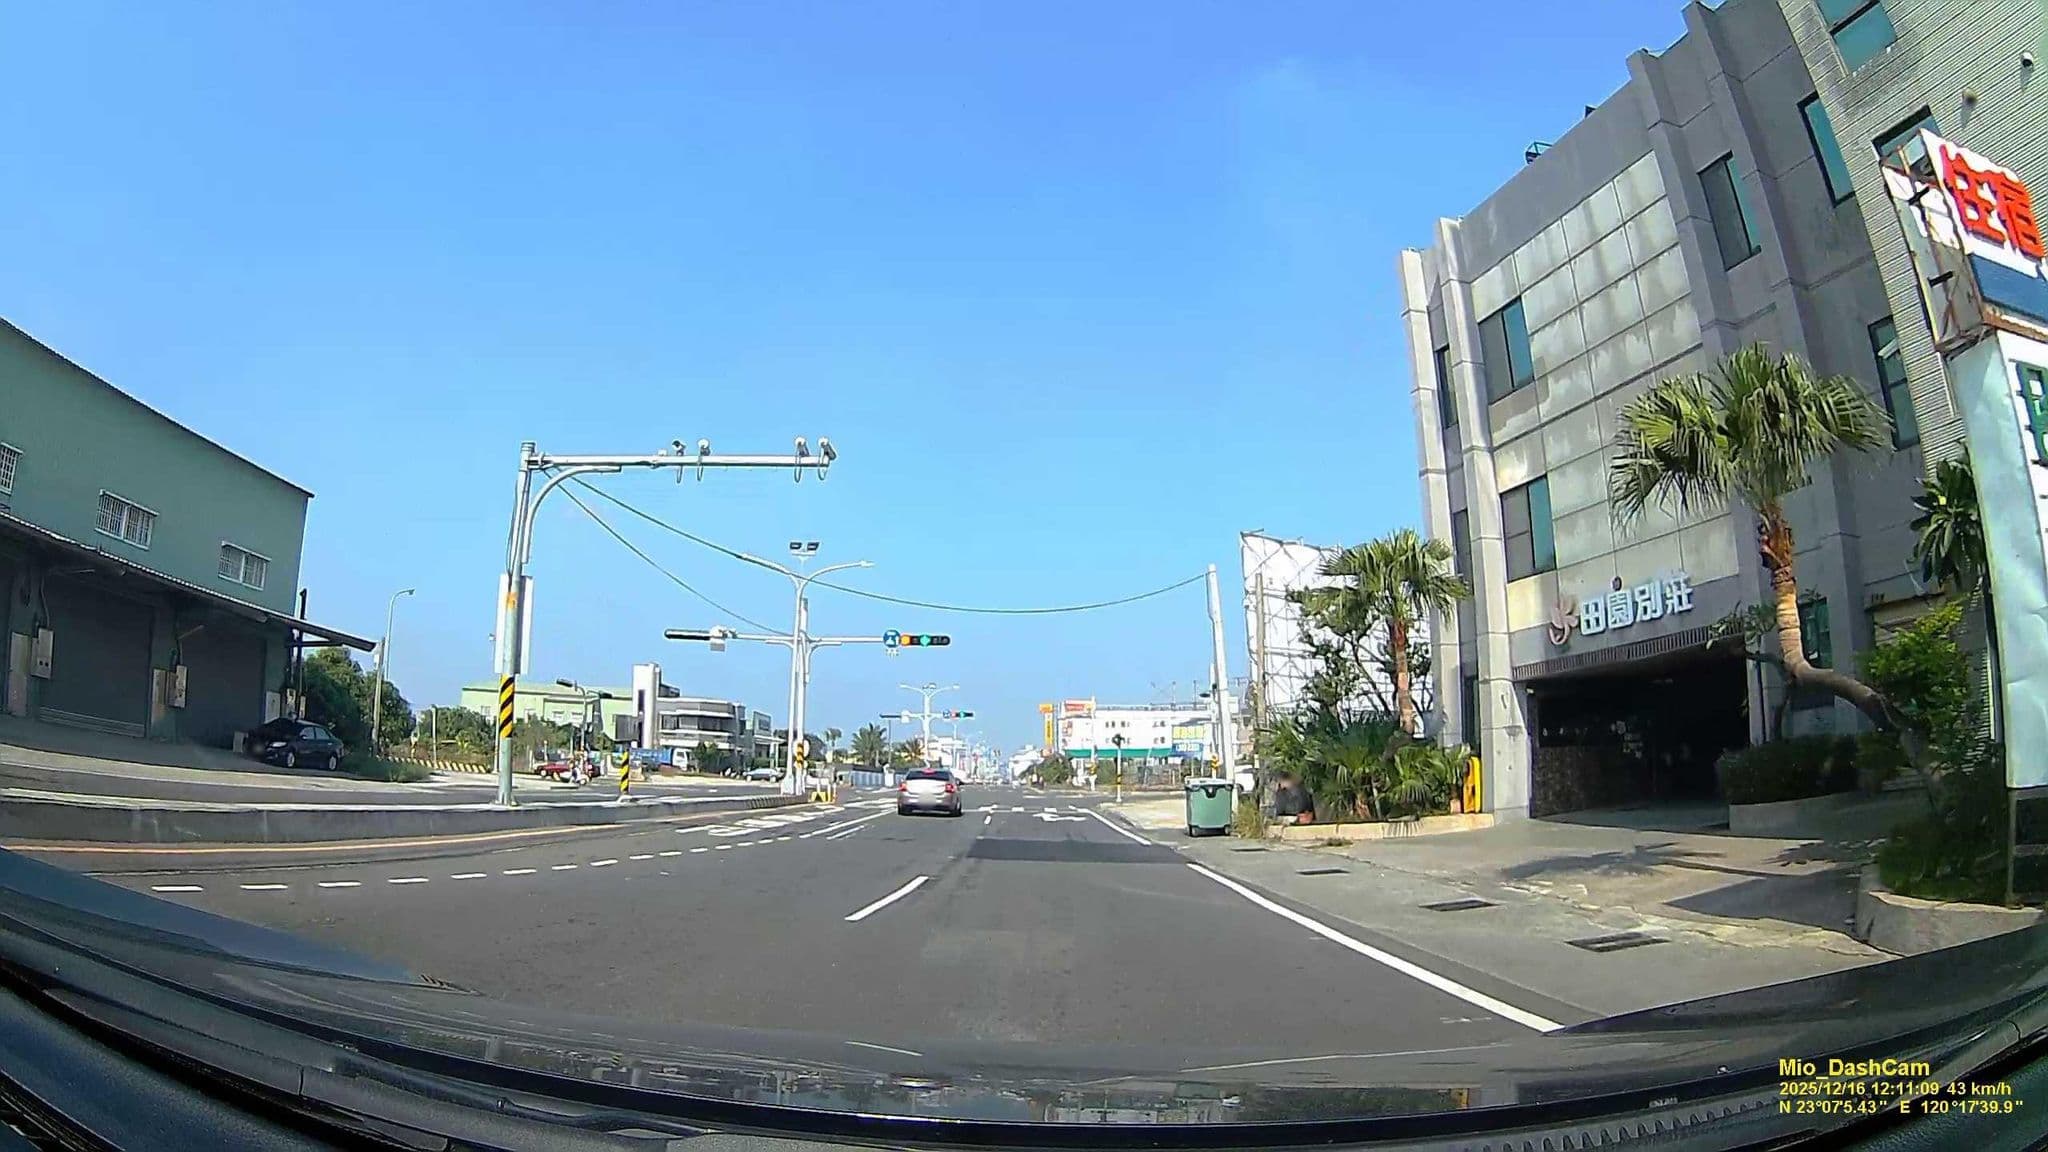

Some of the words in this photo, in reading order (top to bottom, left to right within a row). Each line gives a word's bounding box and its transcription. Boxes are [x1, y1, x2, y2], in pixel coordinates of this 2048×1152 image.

[1940, 144, 2044, 260] 住宿
[1580, 574, 1693, 635] 田園別莊
